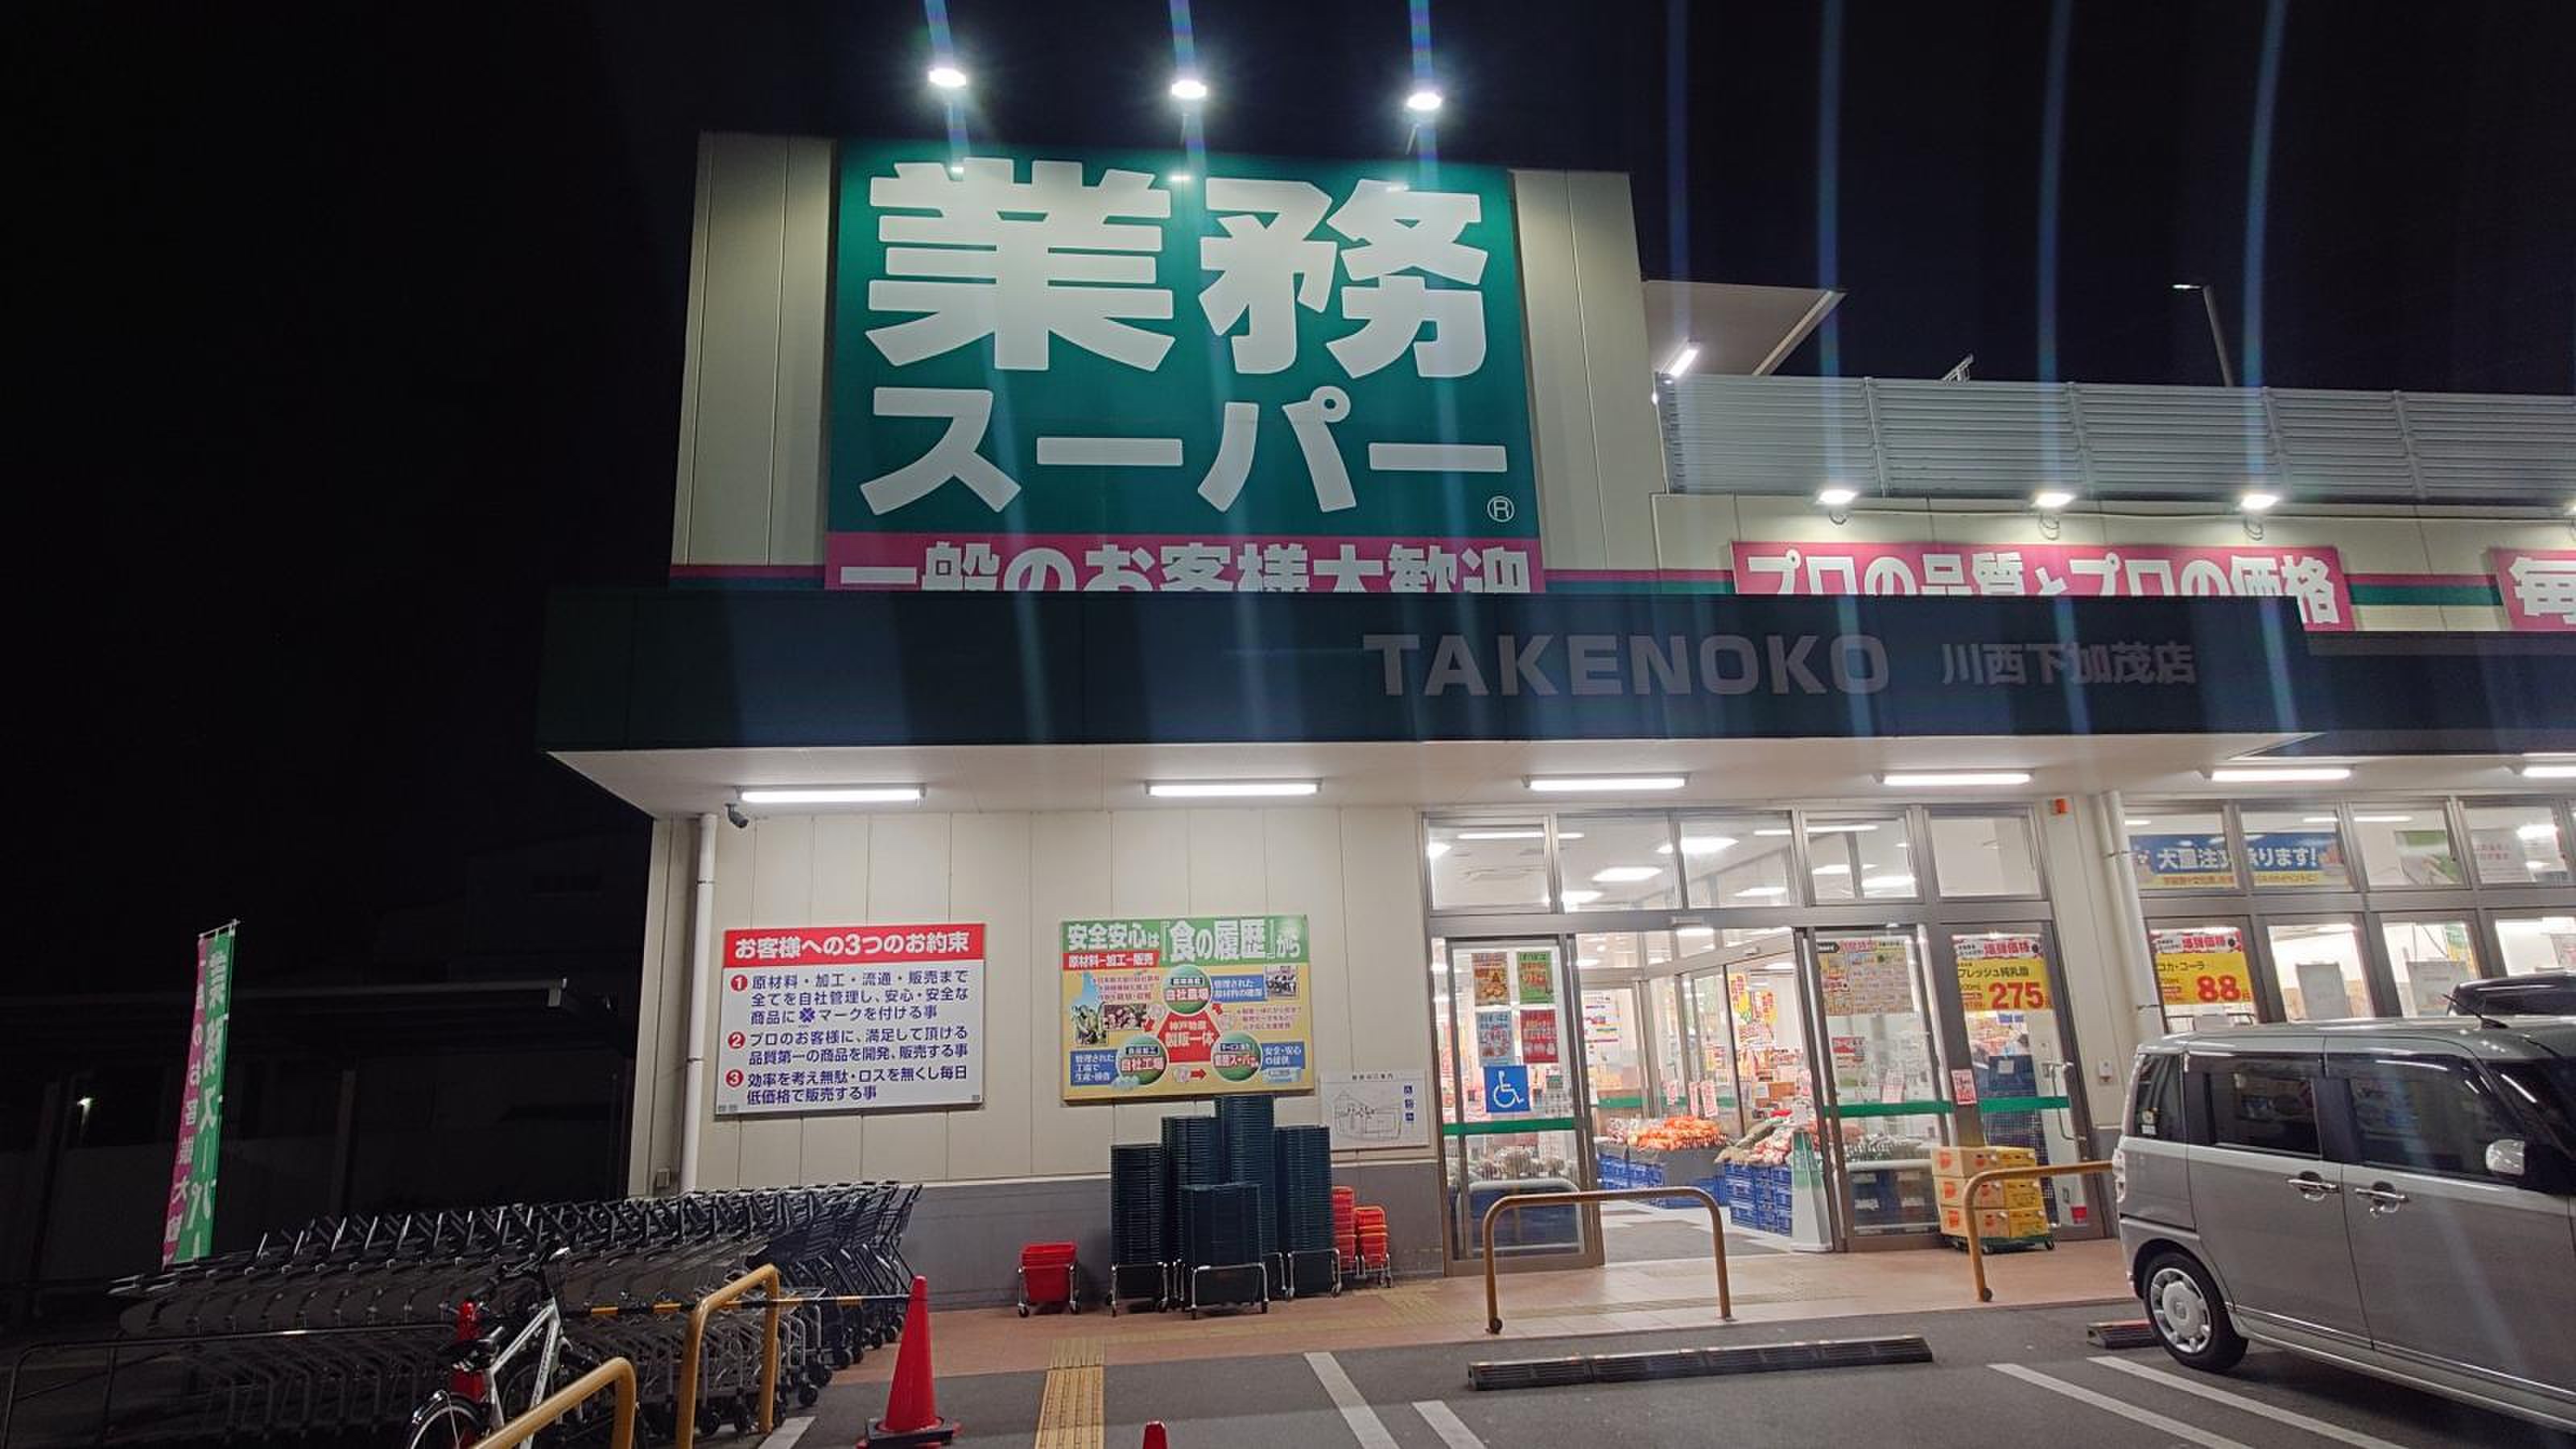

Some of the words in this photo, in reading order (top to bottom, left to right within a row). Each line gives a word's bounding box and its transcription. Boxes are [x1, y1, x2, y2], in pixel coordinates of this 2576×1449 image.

[865, 158, 1489, 378] 業務
[859, 386, 1509, 515] スーパー
[1363, 634, 1890, 698] TAKENOKO
[1942, 641, 2197, 687] 川西下加茂店
[734, 931, 970, 960] お客様への3つのお約束
[1988, 982, 2044, 1009] 275
[2197, 975, 2242, 1002] 88
[747, 1085, 877, 1105] 低価格で販売する事
